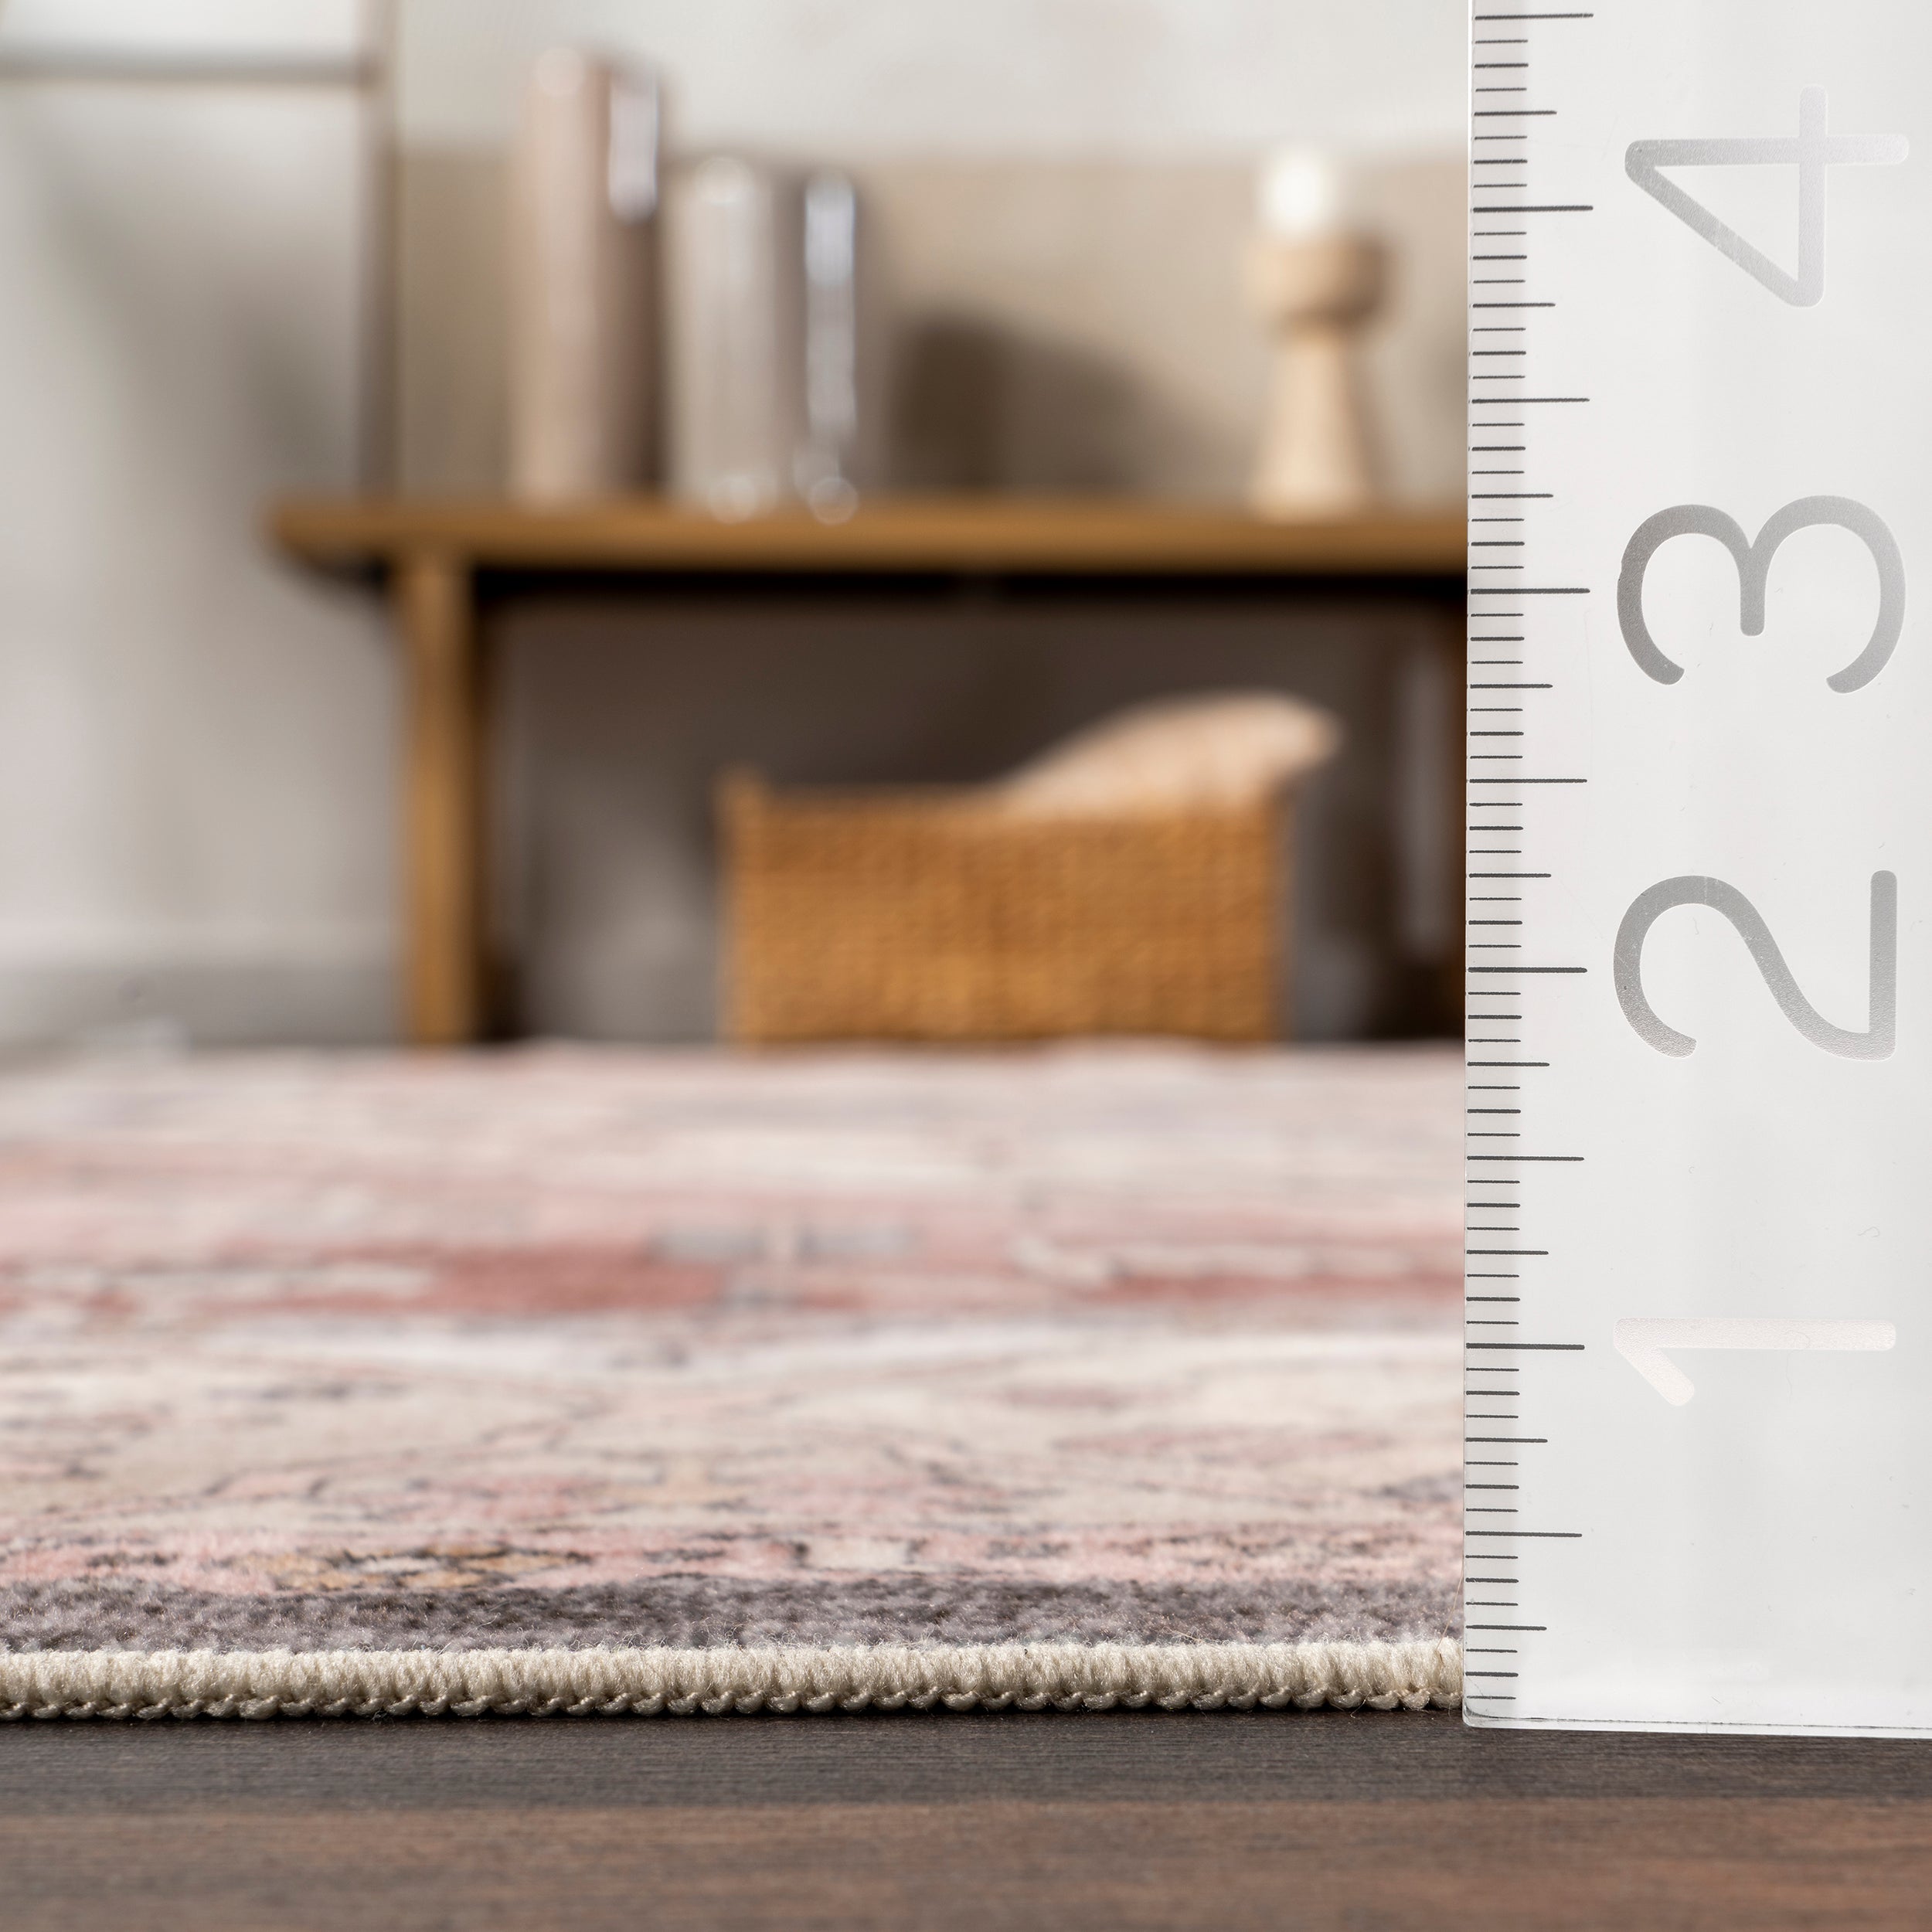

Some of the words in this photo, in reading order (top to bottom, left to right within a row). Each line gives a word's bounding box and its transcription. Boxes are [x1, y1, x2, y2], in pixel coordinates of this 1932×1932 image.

[1624, 85, 1910, 308] 4
[1617, 495, 1906, 694] 3
[1613, 869, 1897, 1061] 2
[1613, 1317, 1897, 1406] 1
